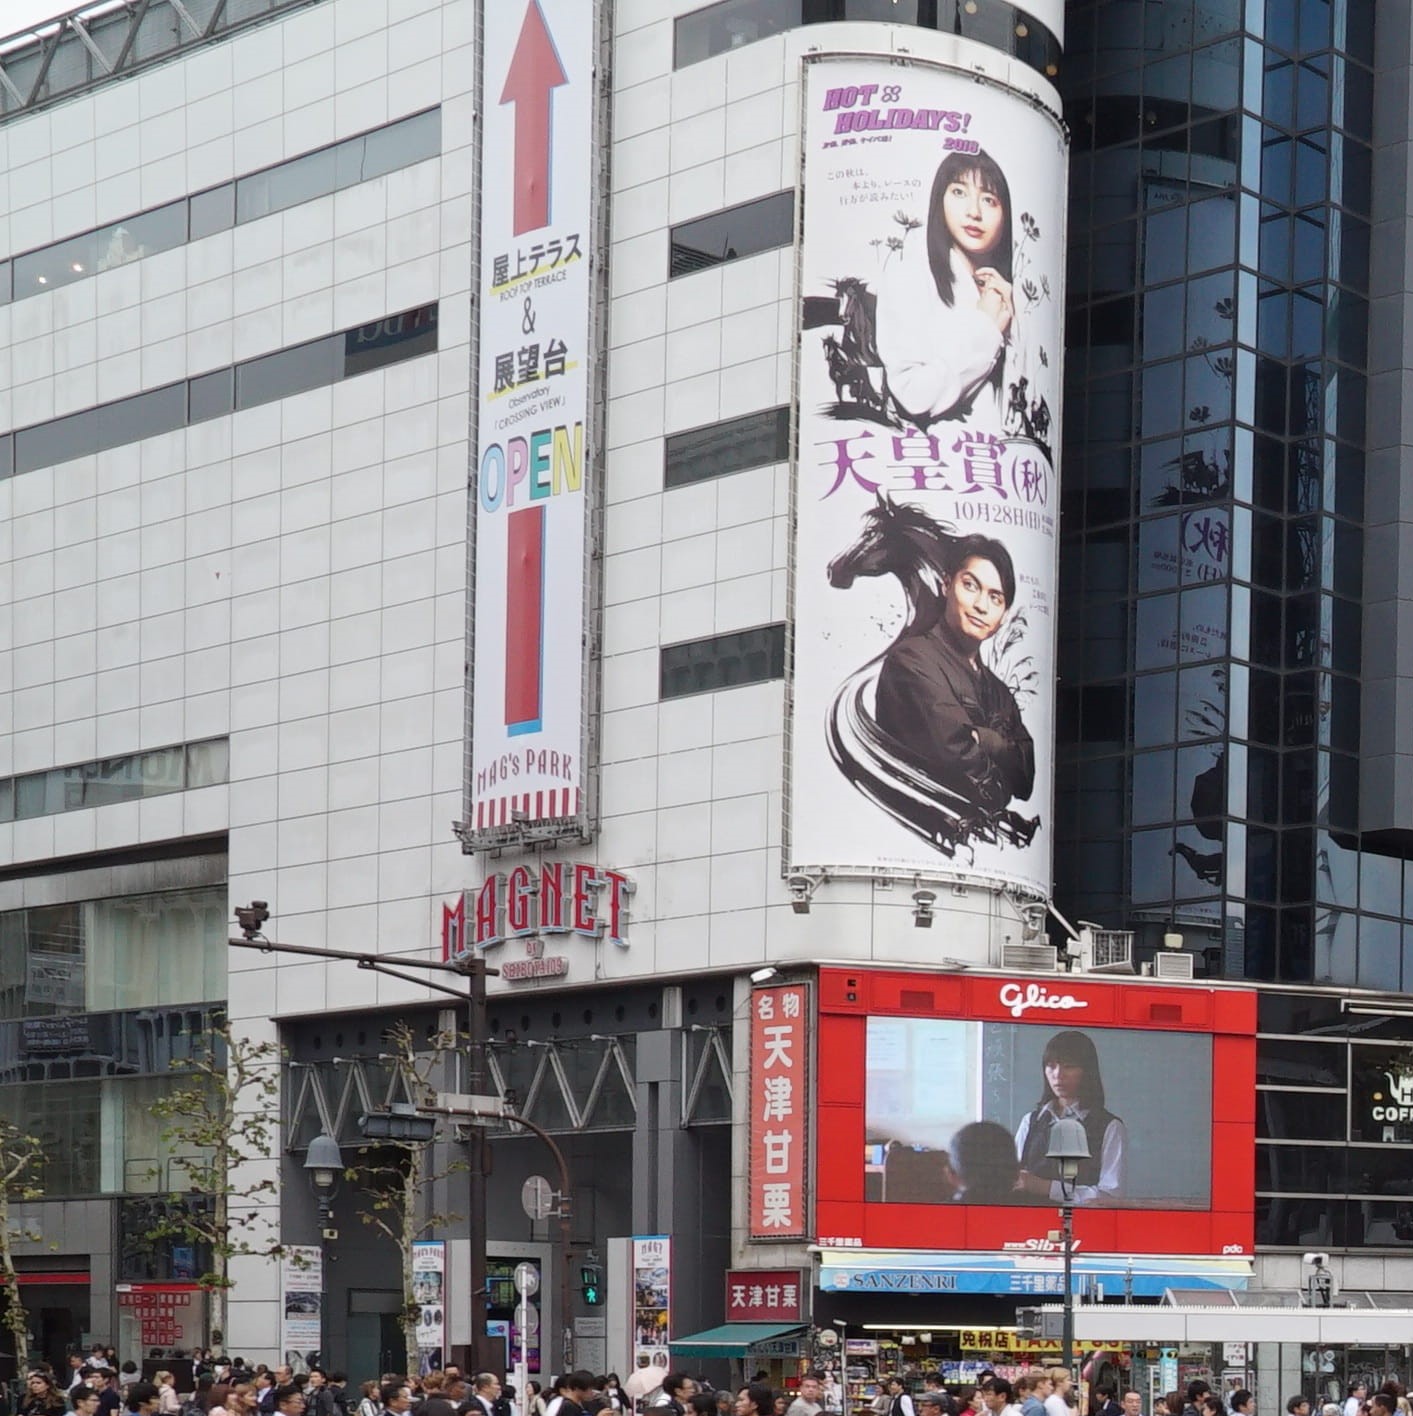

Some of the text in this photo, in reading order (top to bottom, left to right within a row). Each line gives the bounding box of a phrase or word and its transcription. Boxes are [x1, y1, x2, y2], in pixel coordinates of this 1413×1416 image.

[822, 83, 879, 112] HOT
[833, 108, 972, 135] HOLIDAYS!
[942, 137, 980, 153] 2018
[492, 233, 583, 288] 屋上テラス
[522, 296, 537, 335] &
[494, 338, 569, 394] 展望台
[508, 385, 551, 409] Observatory
[479, 421, 583, 512] OPEN
[814, 428, 1048, 508] 天皇賞(秋)
[953, 499, 1042, 531] 10月28日(日)
[526, 747, 573, 782] PARK
[442, 861, 631, 964] MAGNET
[757, 993, 799, 1020] 名物
[999, 983, 1087, 1017] Glico
[762, 1025, 793, 1228] 天津甘栗
[731, 1284, 798, 1308] 天津甘栗
[853, 1272, 957, 1290] SANZENRI
[960, 1331, 1009, 1349] 免税店
